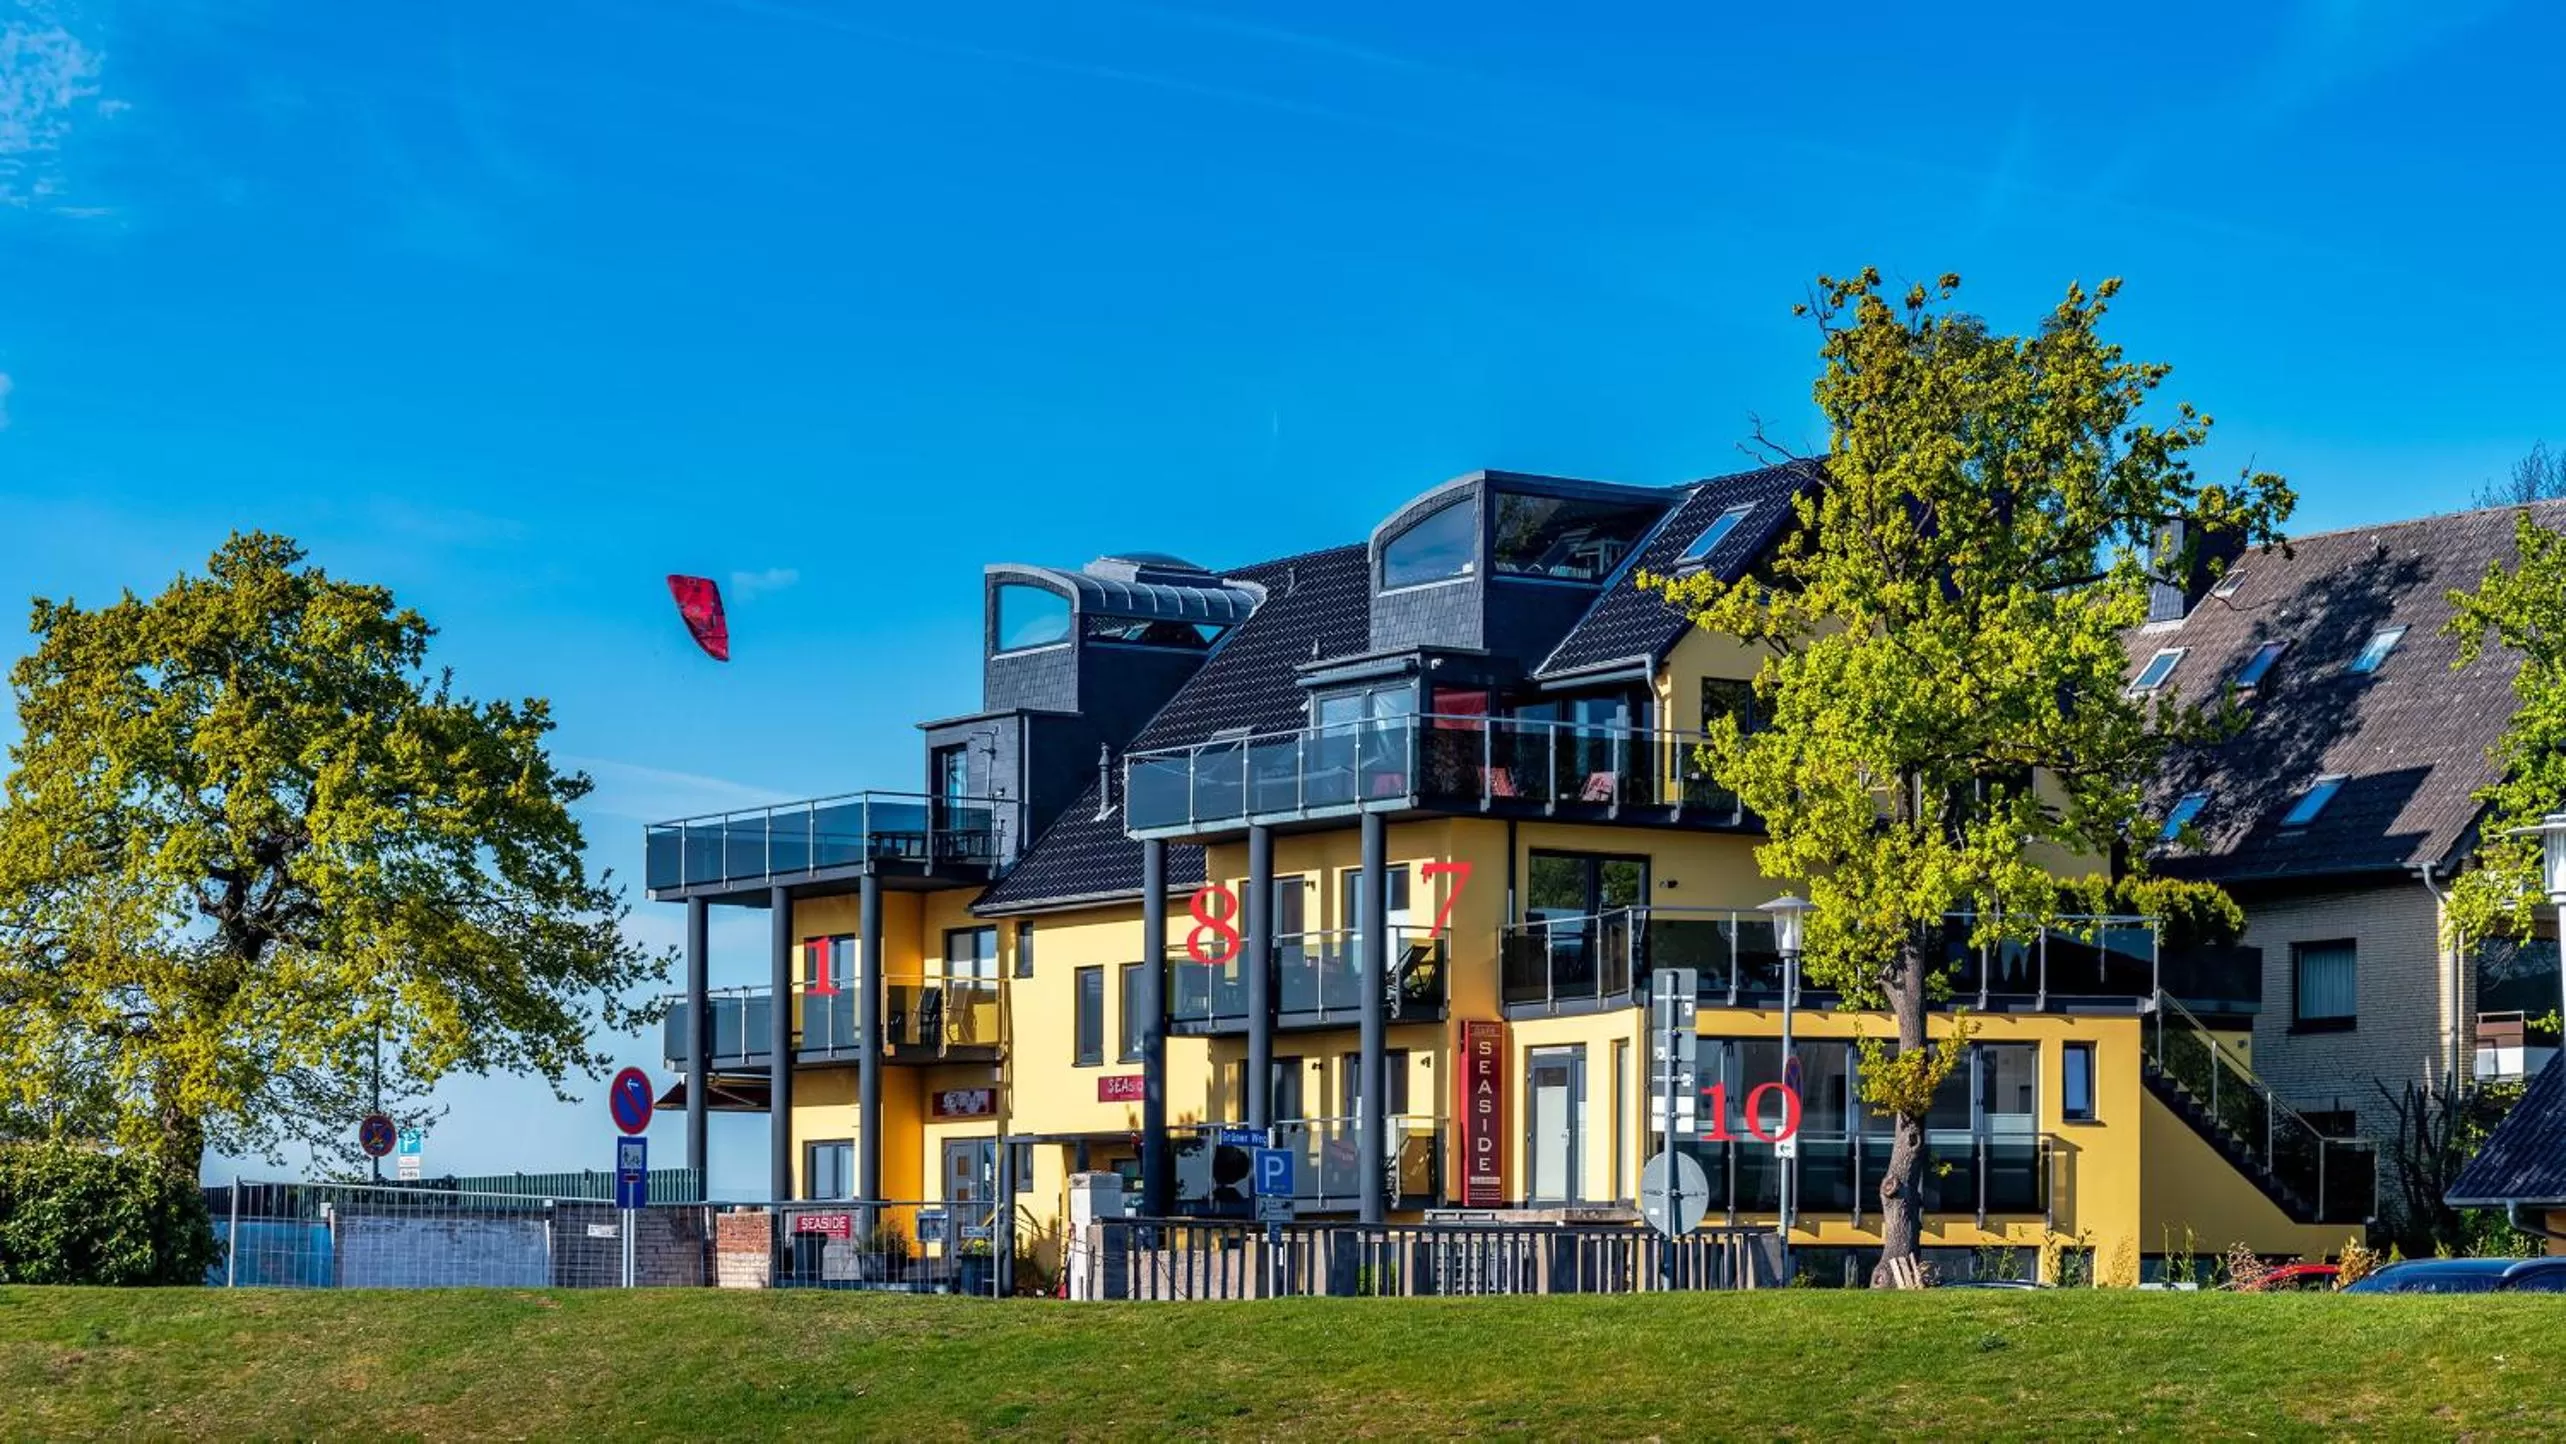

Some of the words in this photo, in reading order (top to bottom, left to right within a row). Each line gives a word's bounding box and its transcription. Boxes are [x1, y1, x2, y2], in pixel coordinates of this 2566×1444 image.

[1477, 1041, 1492, 1171] SEASIDE
[1264, 1155, 1285, 1189] P
[801, 1216, 847, 1230] SEASIDE
